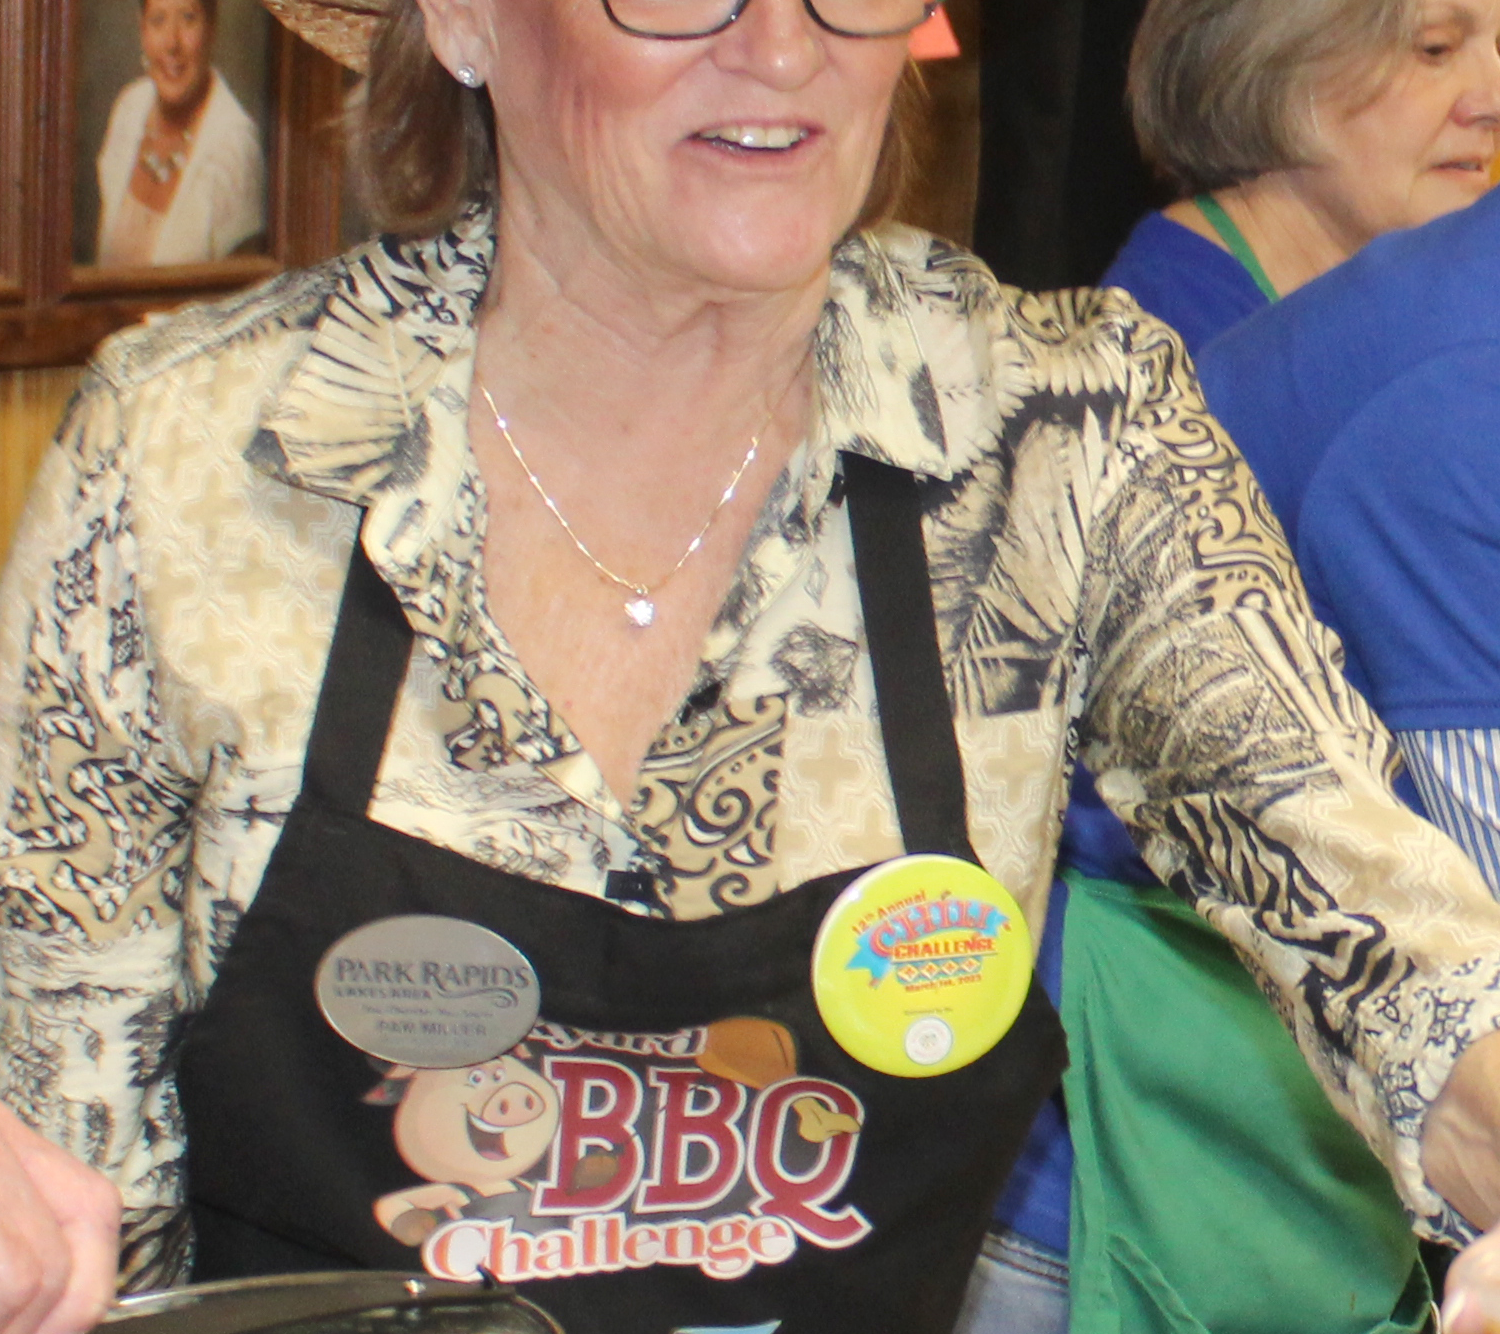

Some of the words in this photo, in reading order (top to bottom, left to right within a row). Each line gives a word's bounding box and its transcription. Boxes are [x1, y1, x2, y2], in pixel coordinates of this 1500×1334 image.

[869, 897, 996, 958] CHILI
[876, 890, 928, 919] Annual
[893, 935, 996, 959] CHALLENGE
[336, 956, 416, 984] PARK
[421, 960, 532, 990] RAPIDS
[531, 1054, 874, 1250] BBQ
[421, 1211, 797, 1284] Challenge
